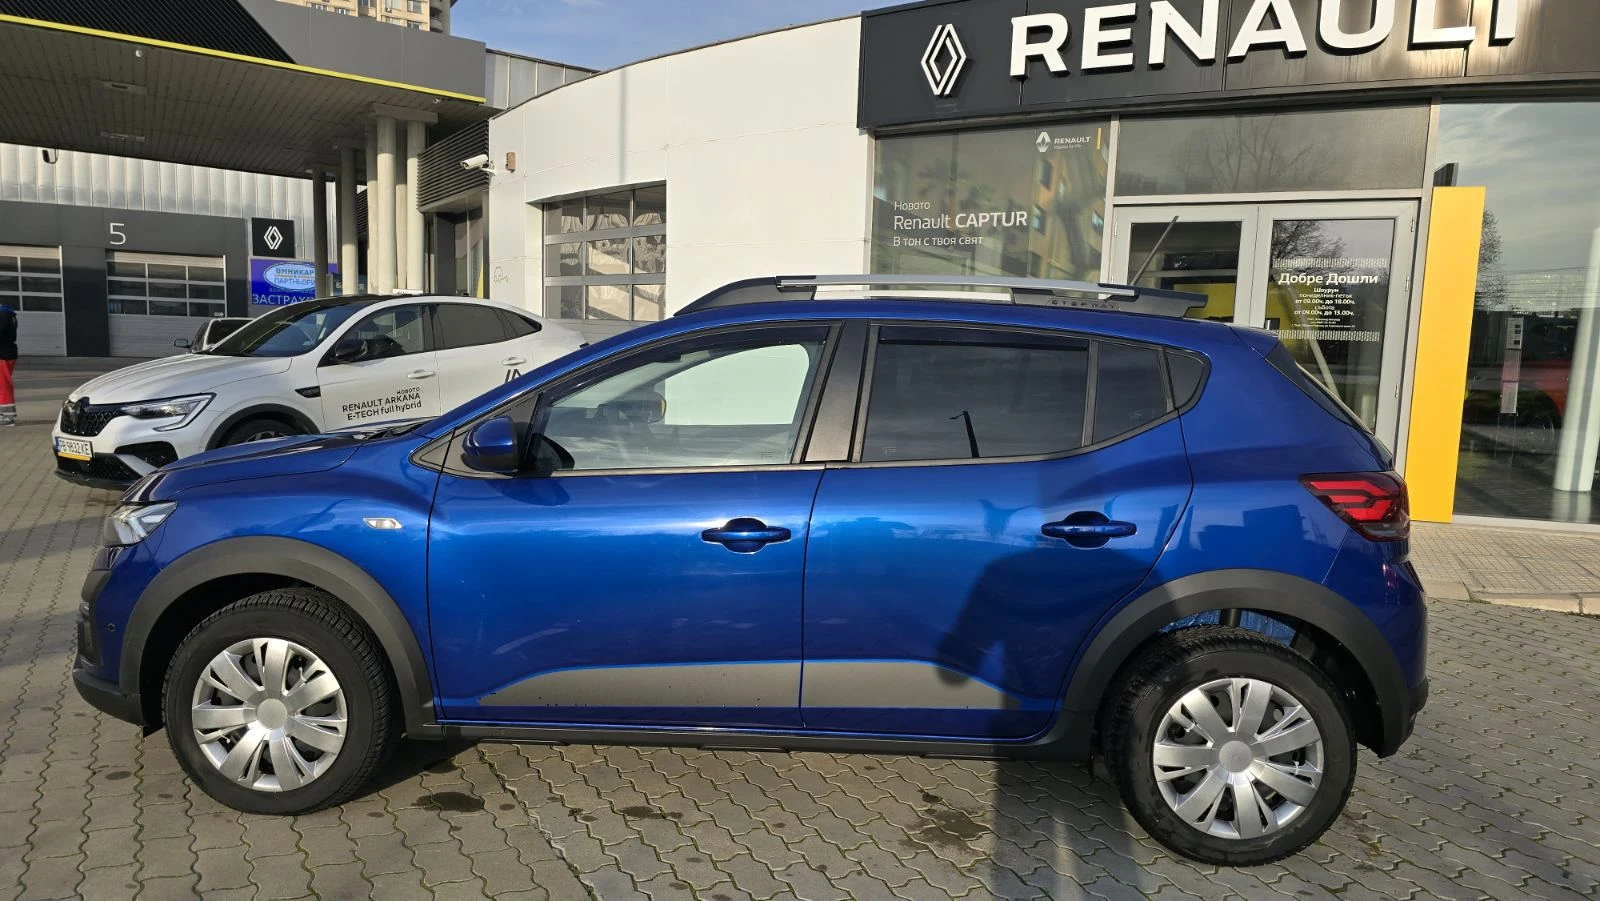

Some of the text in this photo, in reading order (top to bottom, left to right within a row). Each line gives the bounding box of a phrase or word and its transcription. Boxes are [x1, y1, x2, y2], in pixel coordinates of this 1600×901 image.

[1054, 136, 1090, 144] RENAULT
[894, 201, 930, 211] Новото
[894, 211, 1027, 230] Renault CAPTUR
[110, 222, 126, 245] 5
[893, 236, 900, 246] В
[903, 238, 921, 246] тон
[932, 237, 956, 246] твоя
[958, 236, 984, 245] свят
[1278, 273, 1379, 285] Добре Дошли
[342, 392, 421, 413] RENAULT ARKANA
[347, 400, 422, 421] E-TECH full hybrid
